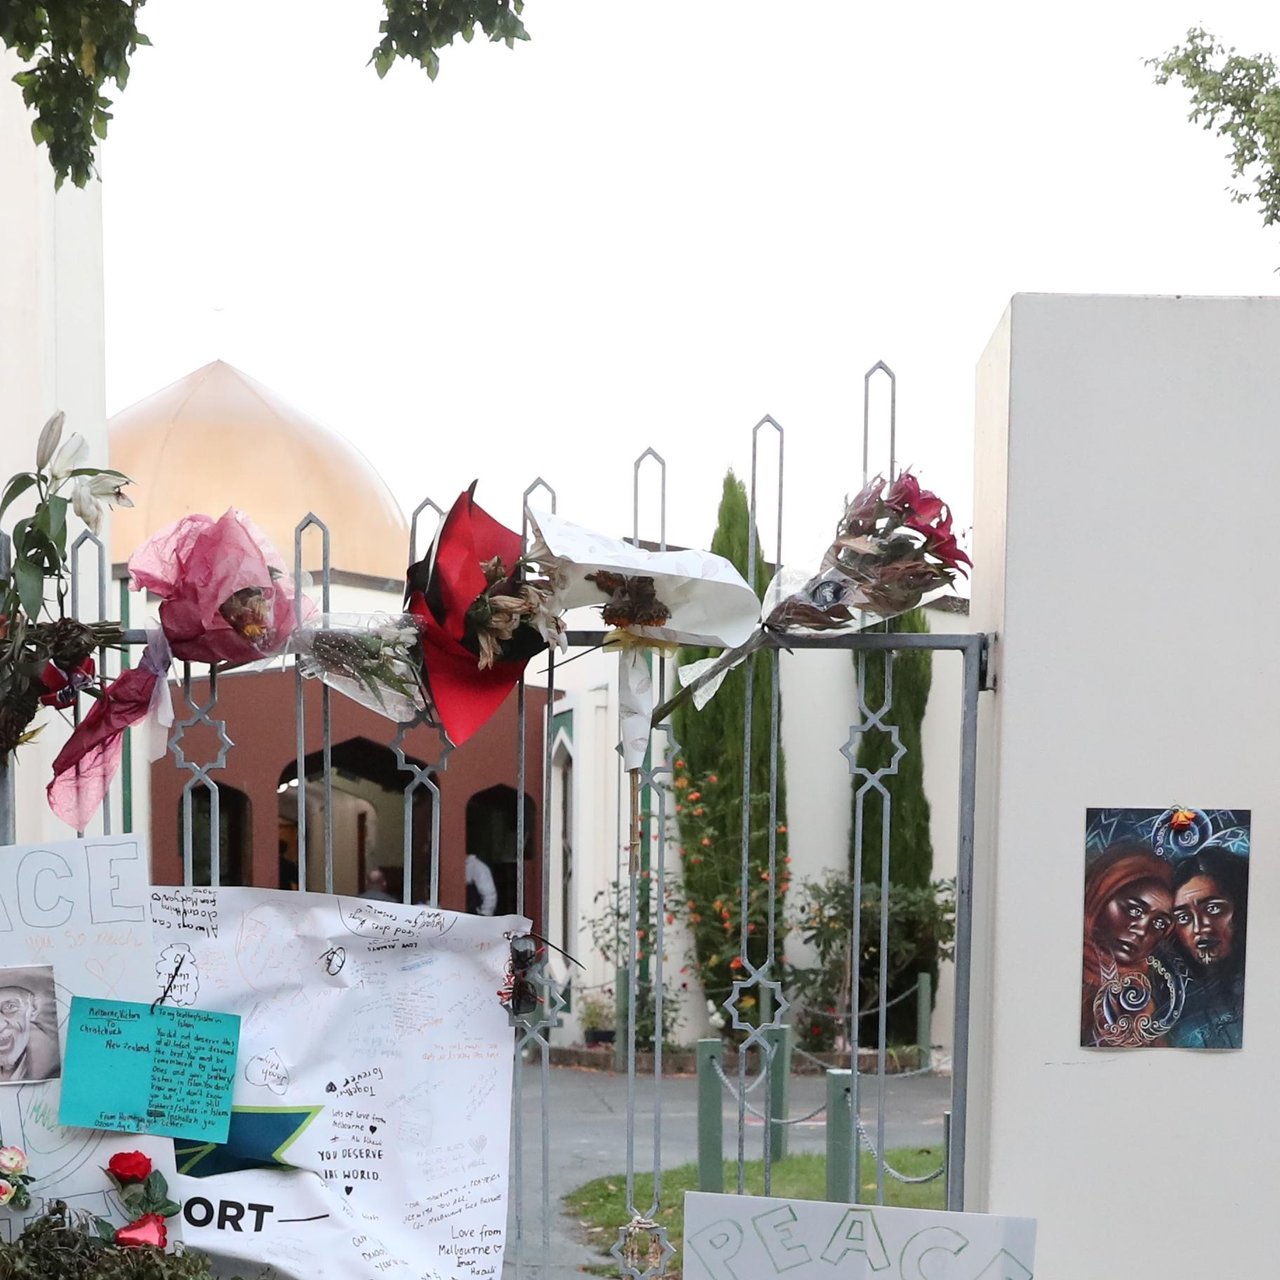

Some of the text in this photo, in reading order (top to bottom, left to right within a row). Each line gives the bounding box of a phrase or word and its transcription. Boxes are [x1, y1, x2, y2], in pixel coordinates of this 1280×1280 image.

[105, 1039, 121, 1049] New
[317, 1149, 384, 1161] YOU DESERVE
[183, 1197, 274, 1233] ORT
[451, 1224, 502, 1241] Love from
[439, 1243, 491, 1256] Melbourne
